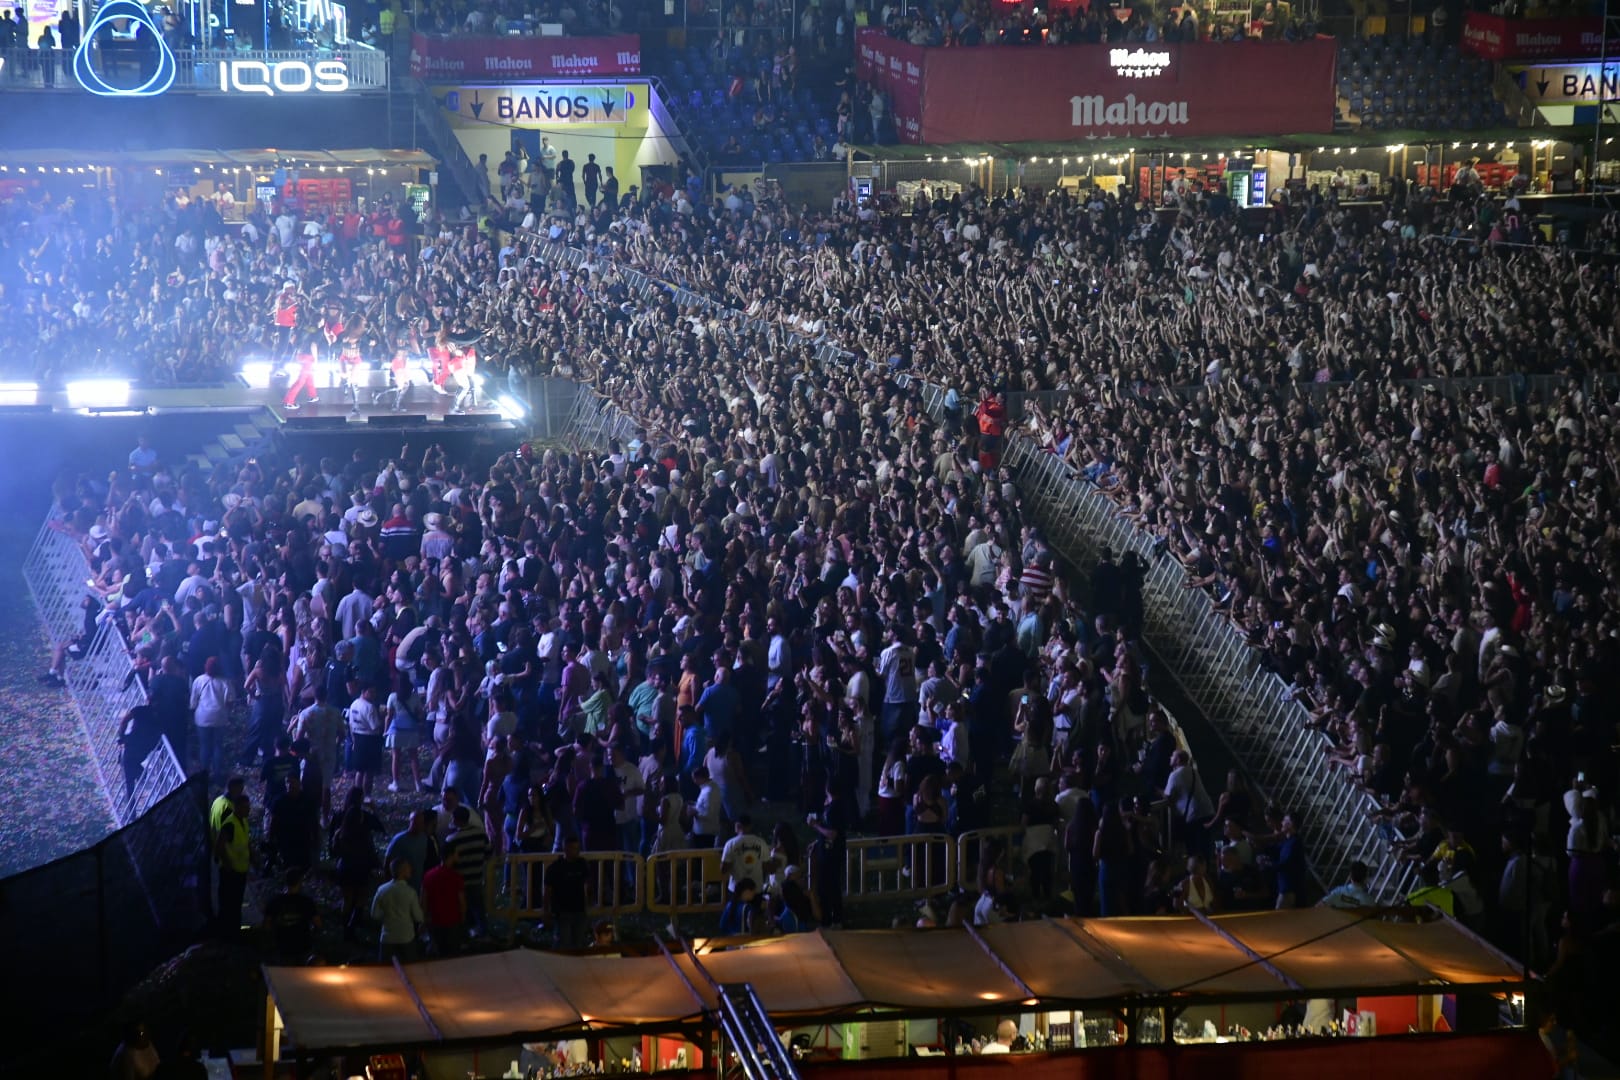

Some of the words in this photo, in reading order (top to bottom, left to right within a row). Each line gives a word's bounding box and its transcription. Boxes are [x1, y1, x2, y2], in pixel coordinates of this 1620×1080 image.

[484, 56, 533, 69] Mahou
[551, 54, 599, 68] Mahou
[1109, 47, 1171, 67] Mahou
[219, 60, 349, 96] IQOS
[497, 89, 590, 118] BAÑOS
[1069, 92, 1190, 126] Mahou
